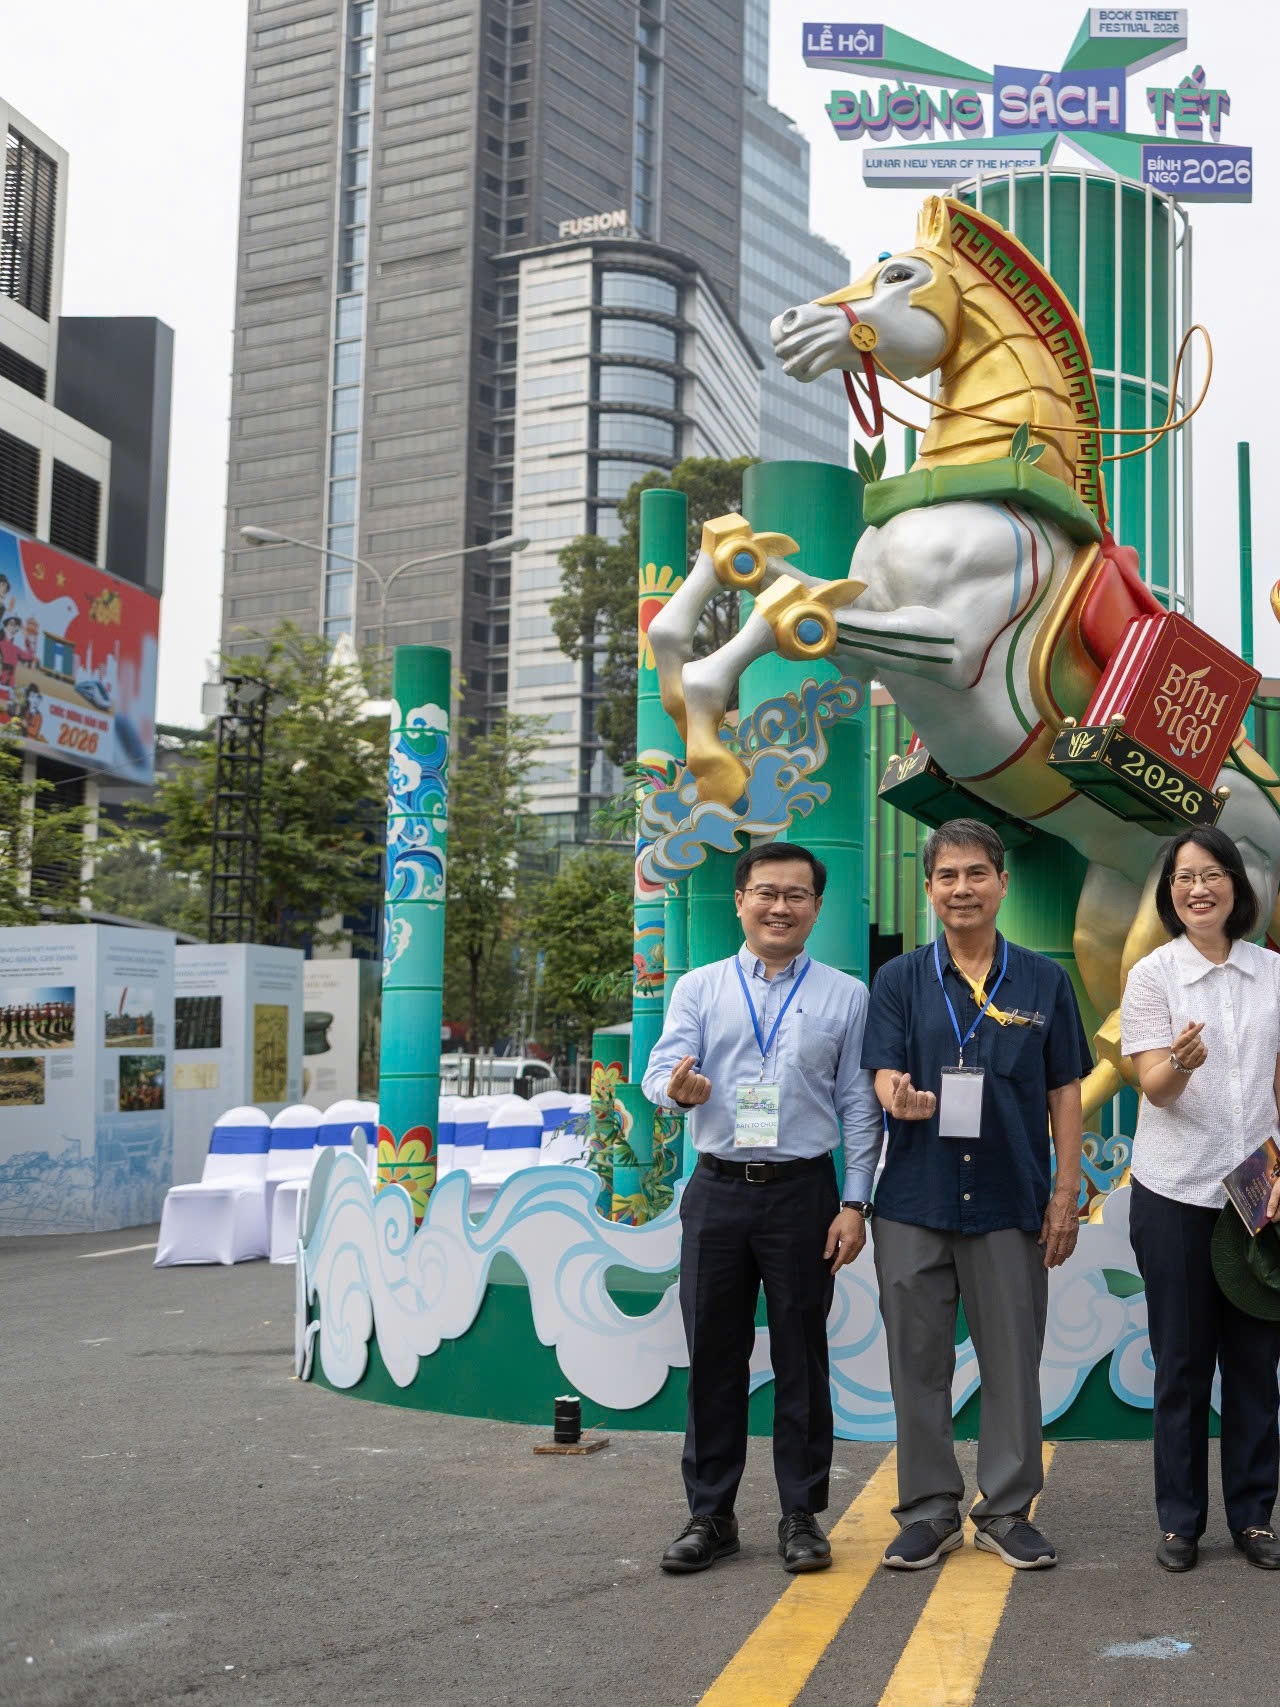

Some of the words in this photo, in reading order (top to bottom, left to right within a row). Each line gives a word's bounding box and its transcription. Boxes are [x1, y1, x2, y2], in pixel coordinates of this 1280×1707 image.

[1099, 11, 1132, 21] BOOK
[1135, 11, 1178, 21] STREET
[1099, 23, 1150, 33] FESTIVAL
[1153, 23, 1180, 33] 2026
[807, 25, 834, 52] LỄ
[838, 29, 875, 55] HỘI
[824, 77, 985, 135] ĐƯỜNG
[998, 73, 1120, 128] SÁCH
[1146, 65, 1231, 136] TẾT
[866, 159, 900, 168] LUNAR
[903, 159, 928, 168] NEW
[931, 159, 957, 168] YEAR
[960, 159, 974, 168] OF
[976, 159, 997, 168] THE
[1147, 155, 1181, 171] BÍNH
[1183, 158, 1251, 185] 2026
[1149, 171, 1180, 185] NGỌ
[558, 209, 627, 238] FUSION
[57, 722, 99, 754] 2026
[1121, 751, 1202, 814] 2026
